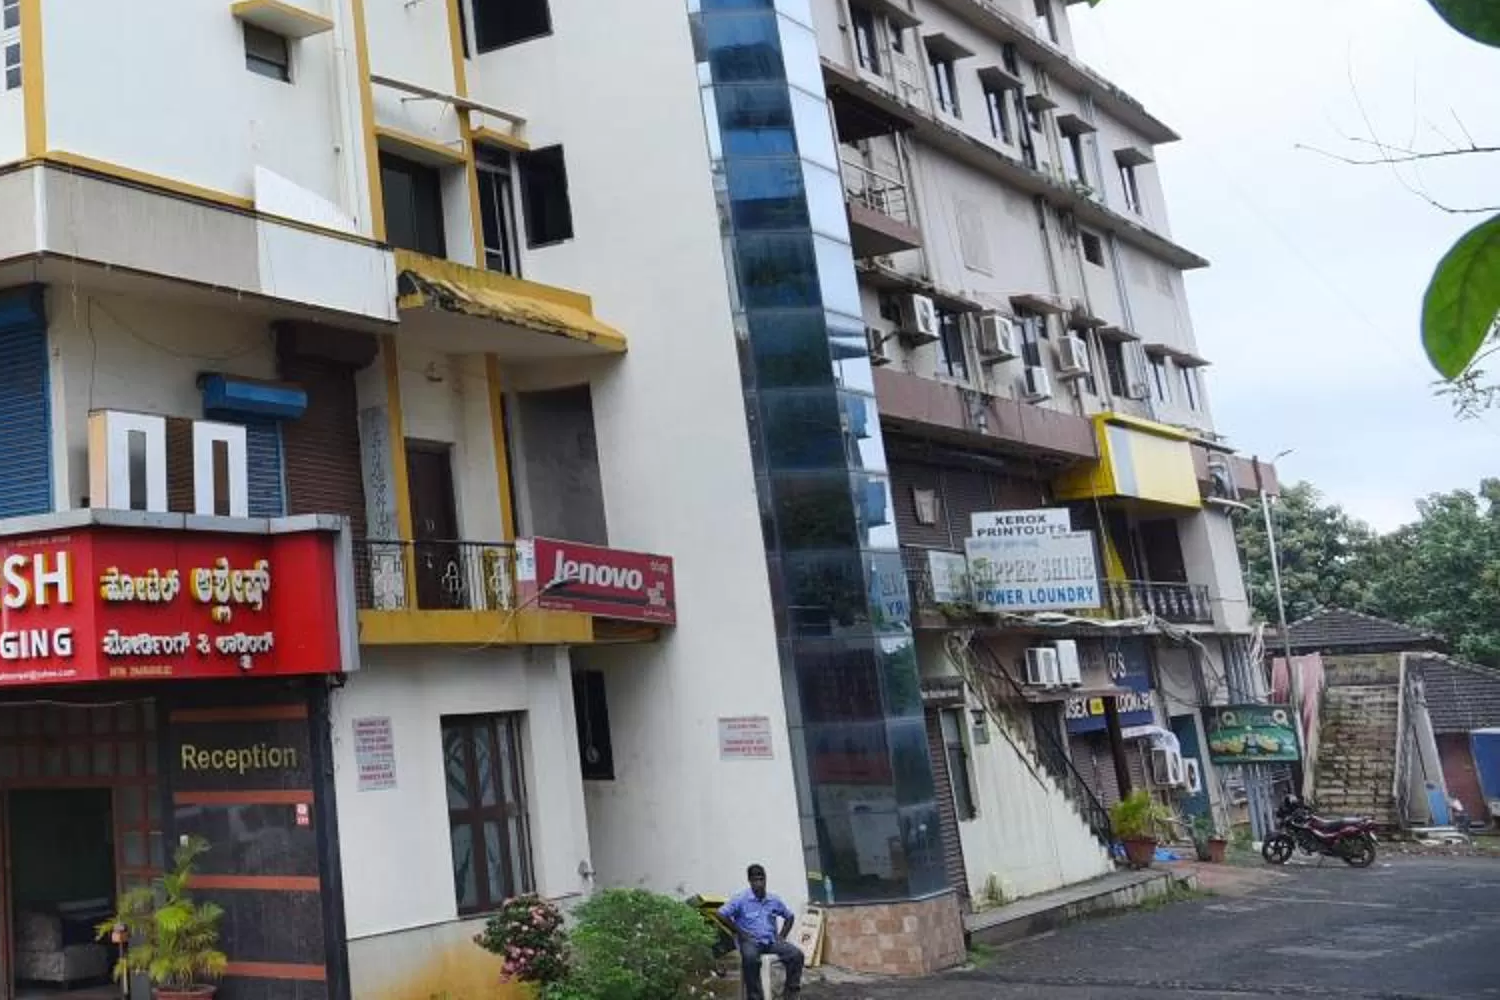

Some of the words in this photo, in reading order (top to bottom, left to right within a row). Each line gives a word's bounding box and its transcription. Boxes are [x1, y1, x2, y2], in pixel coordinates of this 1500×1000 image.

[995, 514, 1047, 526] XEROX
[977, 524, 1067, 537] PRINTOUTS
[1029, 586, 1094, 605] LOUNDRY
[180, 743, 297, 775] Reception
